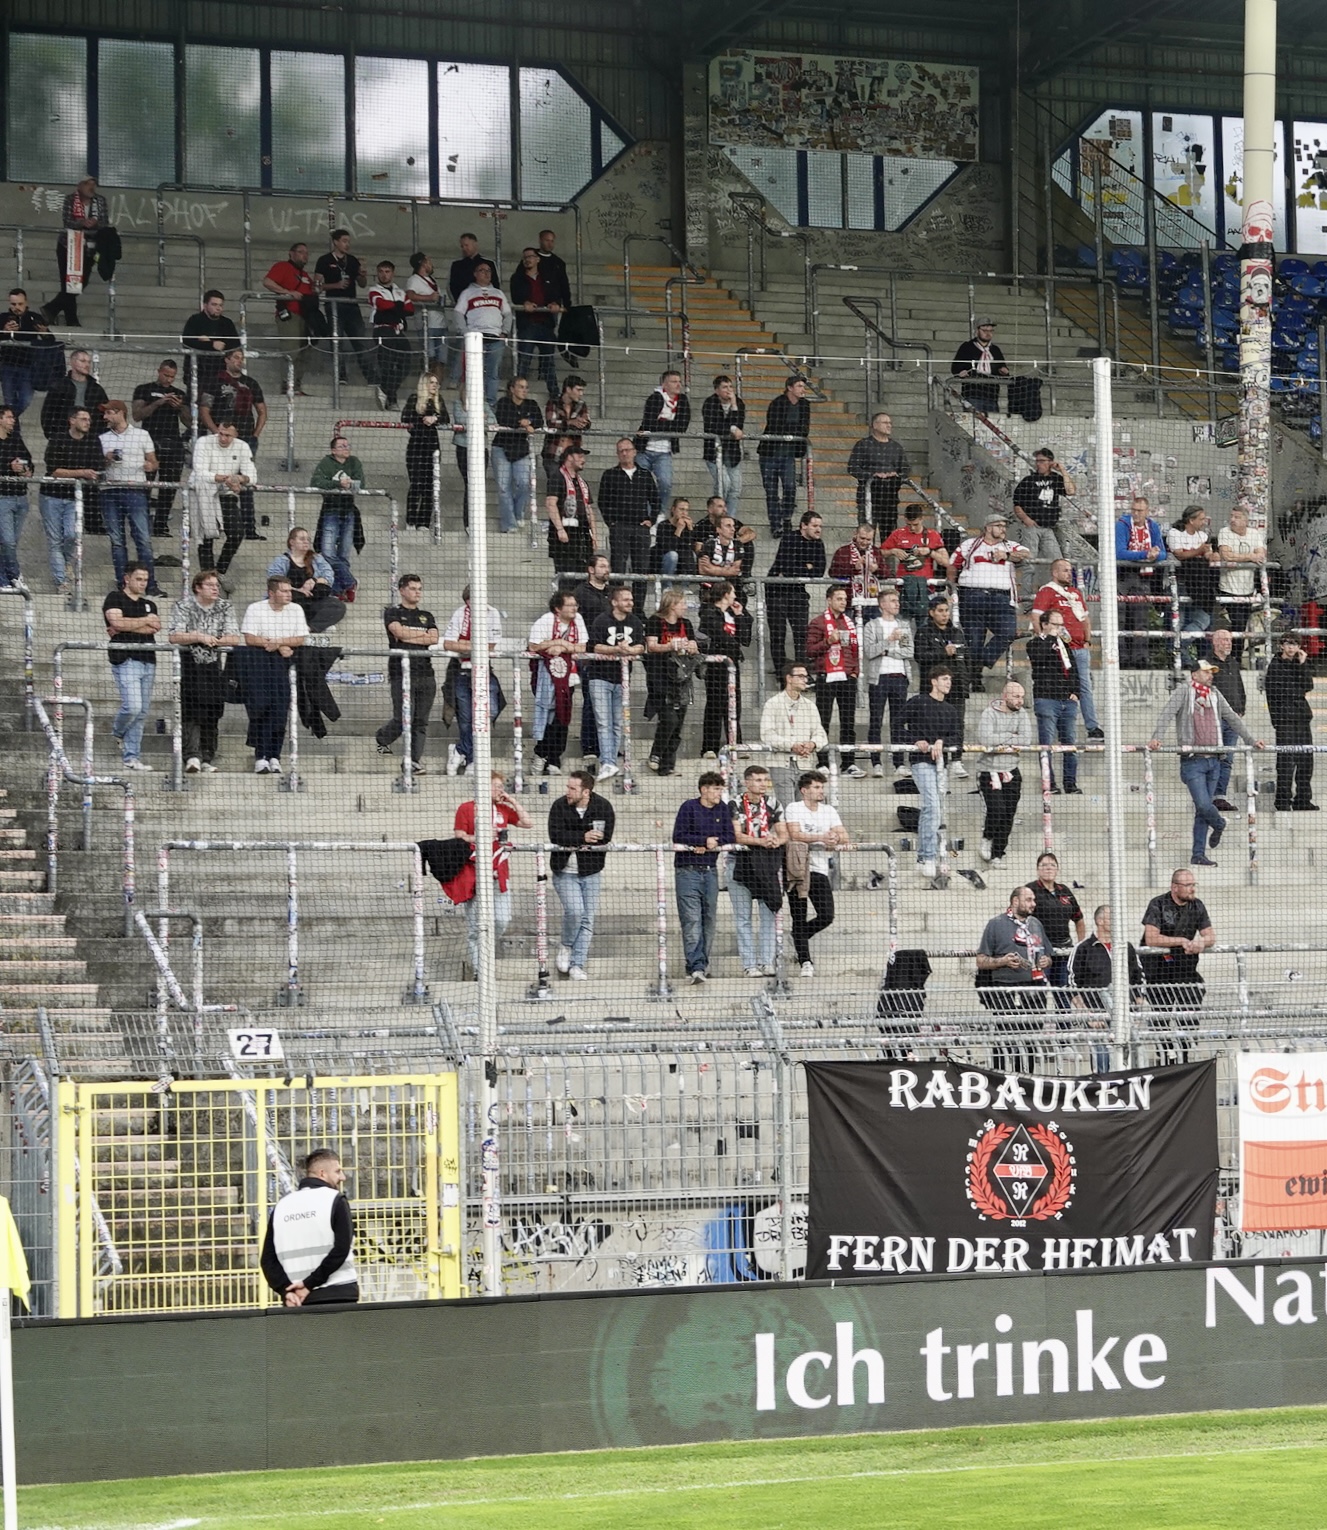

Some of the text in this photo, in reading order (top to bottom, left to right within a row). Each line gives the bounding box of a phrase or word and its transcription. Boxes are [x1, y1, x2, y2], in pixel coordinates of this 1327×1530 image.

[236, 1033, 273, 1056] 27
[888, 1068, 1155, 1113] RABAUKEN
[283, 1210, 317, 1223] ORDNER
[1011, 1219, 1027, 1228] 2012
[827, 1227, 1197, 1274] FERN DER HEIMAT
[755, 1309, 1168, 1411] Ich trinke
